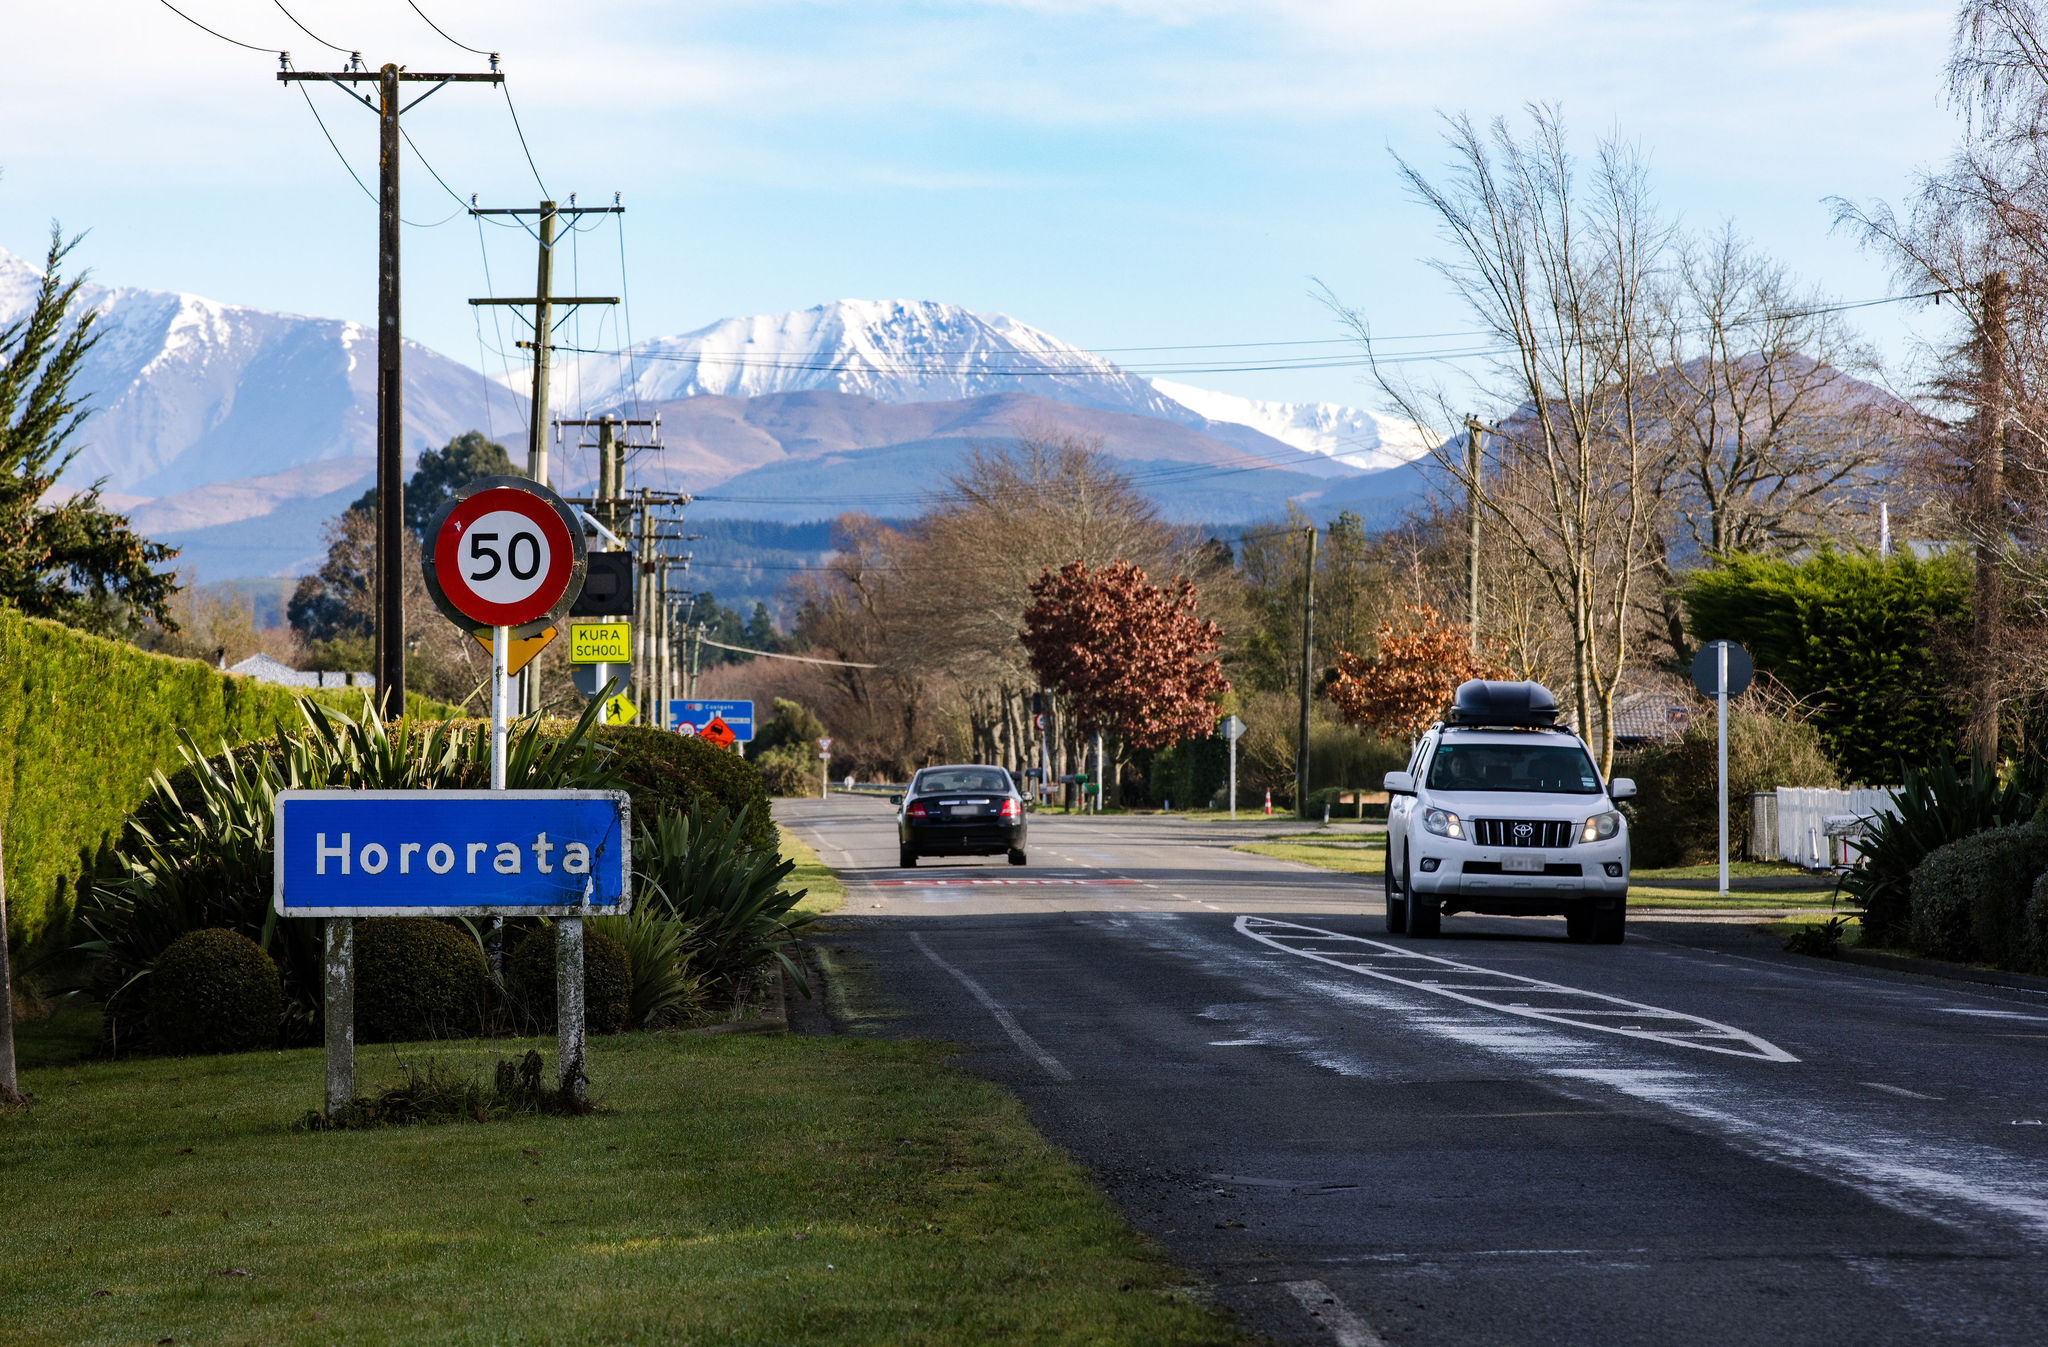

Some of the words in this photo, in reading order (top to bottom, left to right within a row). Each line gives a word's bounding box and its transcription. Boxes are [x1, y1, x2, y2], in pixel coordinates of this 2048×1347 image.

[470, 531, 541, 582] 50
[579, 630, 620, 640] KURA
[576, 645, 625, 656] SCHOOL
[316, 831, 591, 875] Hororata
